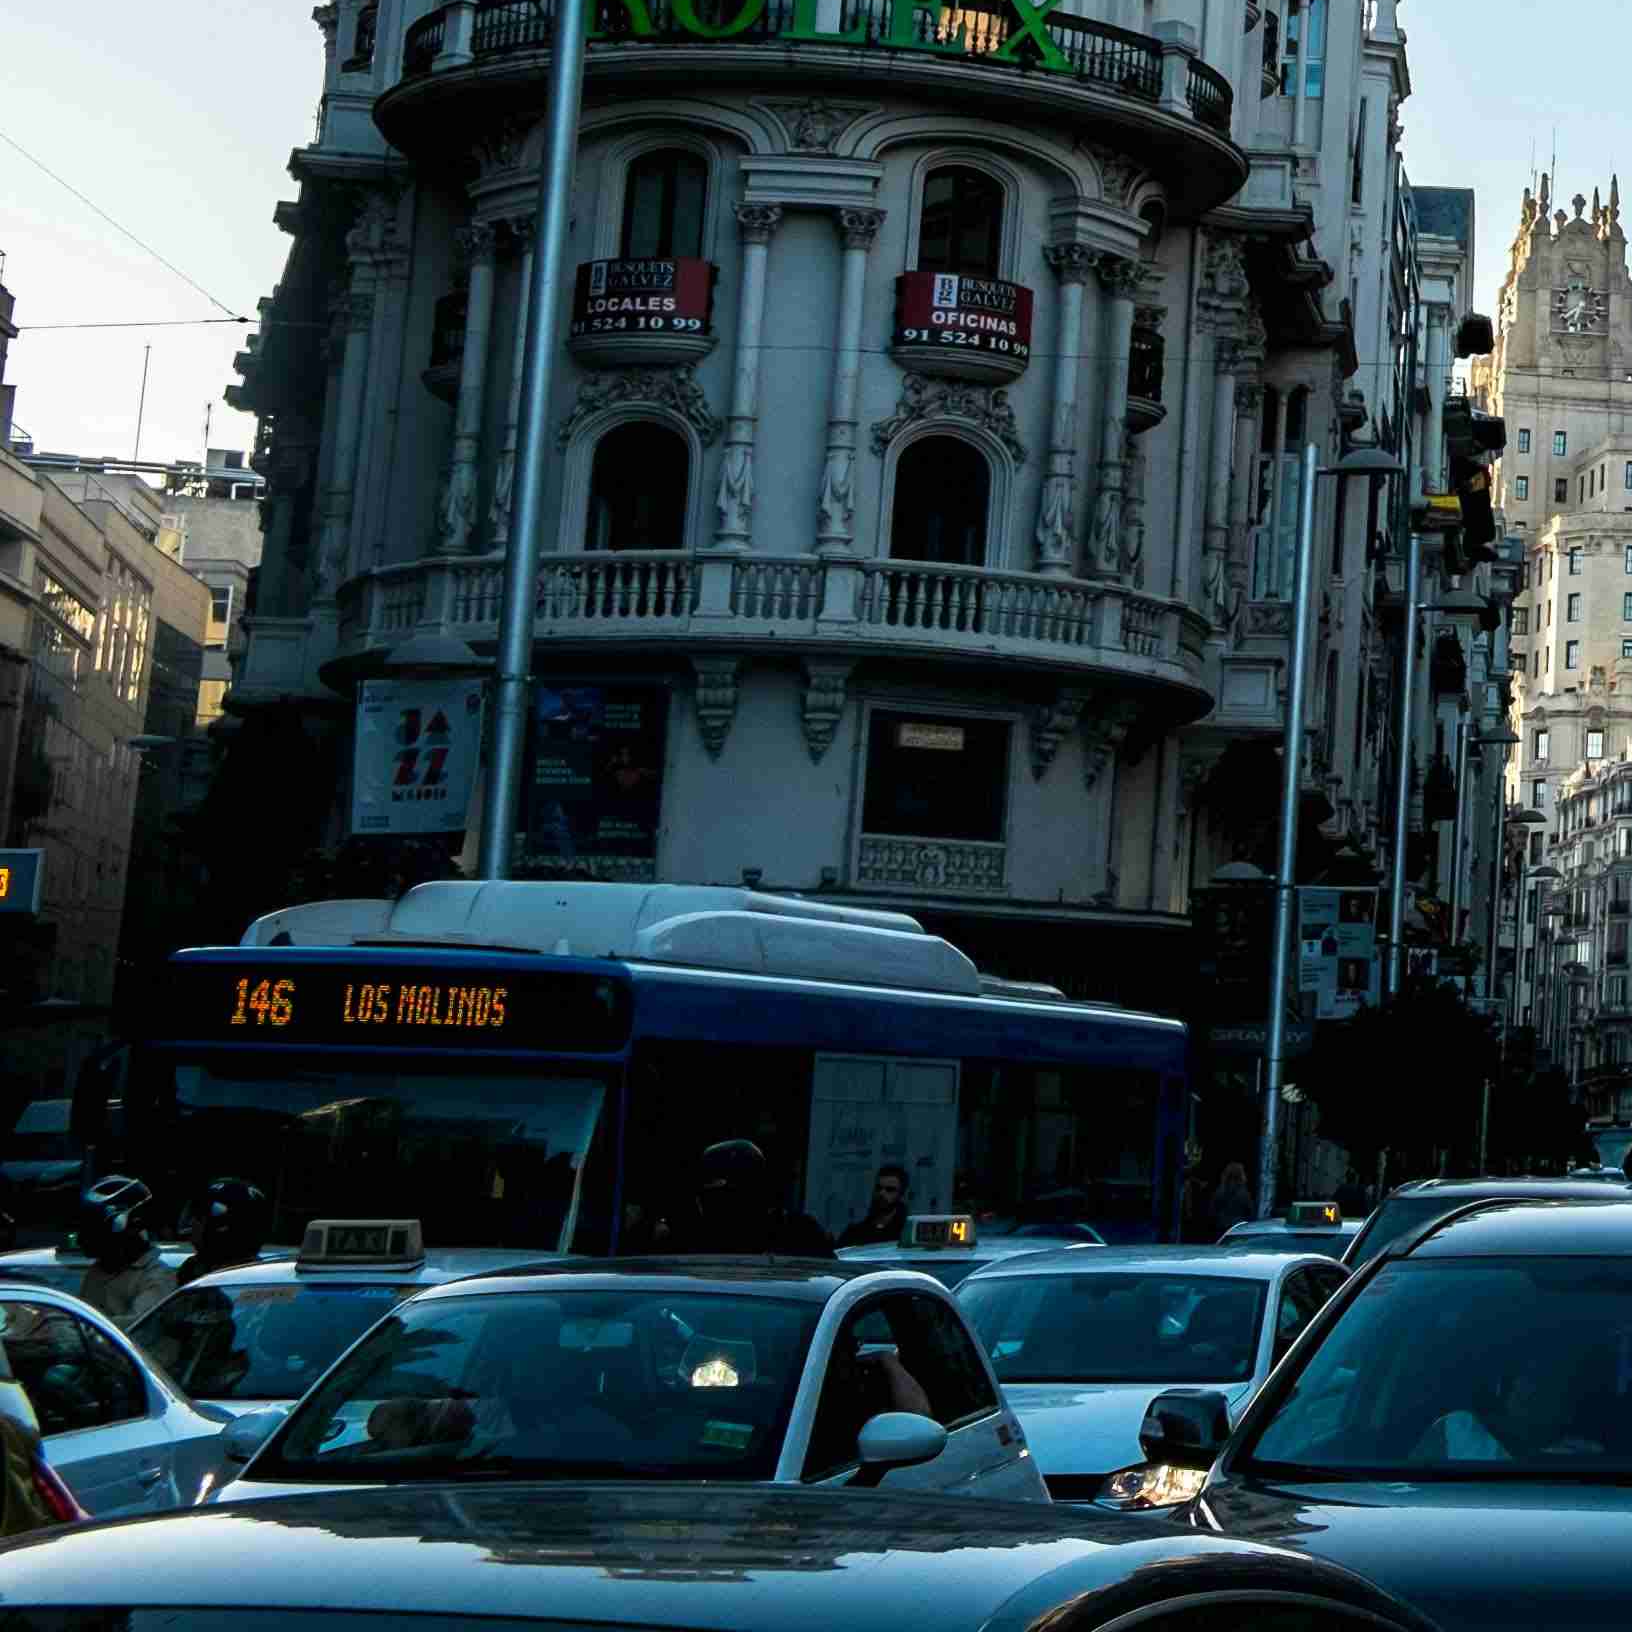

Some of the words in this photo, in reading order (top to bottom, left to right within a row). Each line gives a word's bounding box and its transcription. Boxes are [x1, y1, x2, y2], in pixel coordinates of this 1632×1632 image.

[608, 260, 675, 275] BUSQUETS
[586, 296, 677, 315] LOCALES
[591, 316, 627, 330] 524
[636, 315, 664, 330] 10
[671, 318, 702, 332] 99
[931, 310, 1017, 337] OFICINAS
[903, 328, 929, 342] 91
[938, 330, 980, 346] 524
[988, 335, 1009, 352] 10
[1012, 342, 1029, 356] 99
[229, 977, 296, 1026] 146
[343, 983, 392, 1025] LOS
[396, 983, 509, 1026] MOLINOS
[951, 1221, 966, 1241] 4
